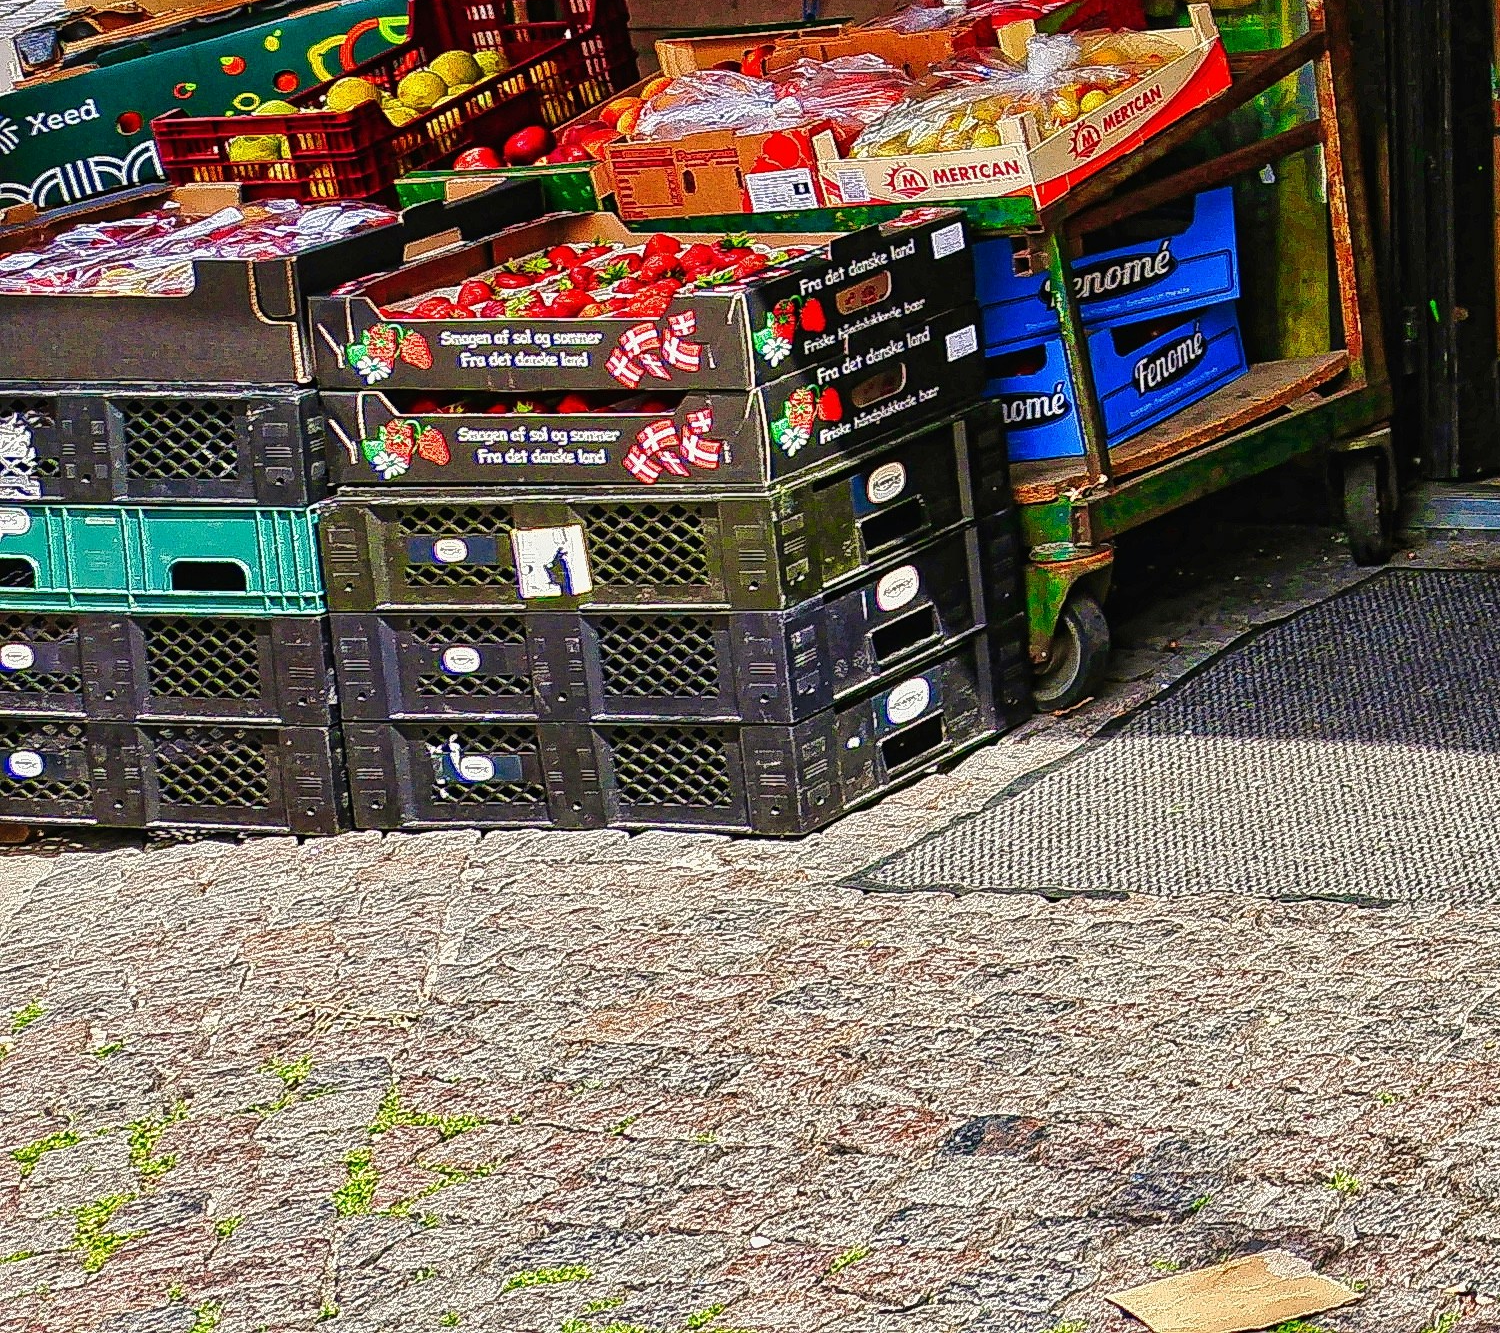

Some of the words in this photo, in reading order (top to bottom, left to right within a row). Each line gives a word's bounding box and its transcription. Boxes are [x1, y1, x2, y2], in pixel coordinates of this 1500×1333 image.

[30, 97, 101, 136] Xeed
[1101, 83, 1163, 135] MERTCAN
[931, 156, 1021, 186] MERTCAN
[799, 275, 821, 297] Fra
[822, 266, 847, 289] det
[848, 249, 890, 281] danske
[891, 238, 916, 265] land
[1042, 237, 1174, 305] enomé
[440, 331, 489, 349] Smagen
[512, 329, 532, 345] sol
[553, 330, 602, 346] sommer
[803, 333, 836, 359] Friske
[901, 296, 926, 319] bær
[460, 351, 483, 368] Fra
[486, 351, 509, 368] det
[512, 351, 560, 368] danske
[563, 351, 589, 368] land
[816, 360, 838, 384] Fra
[839, 354, 863, 379] det
[864, 337, 905, 369] danske
[905, 325, 931, 352] land
[1135, 317, 1207, 394] Fenomé
[457, 426, 507, 446] Smagen
[529, 424, 548, 441] sol
[570, 425, 620, 441] sommer
[819, 421, 851, 447] Friske
[916, 385, 940, 407] bær
[477, 448, 500, 467] Fra
[503, 448, 525, 467] det
[530, 448, 575, 467] danske
[579, 448, 605, 467] land
